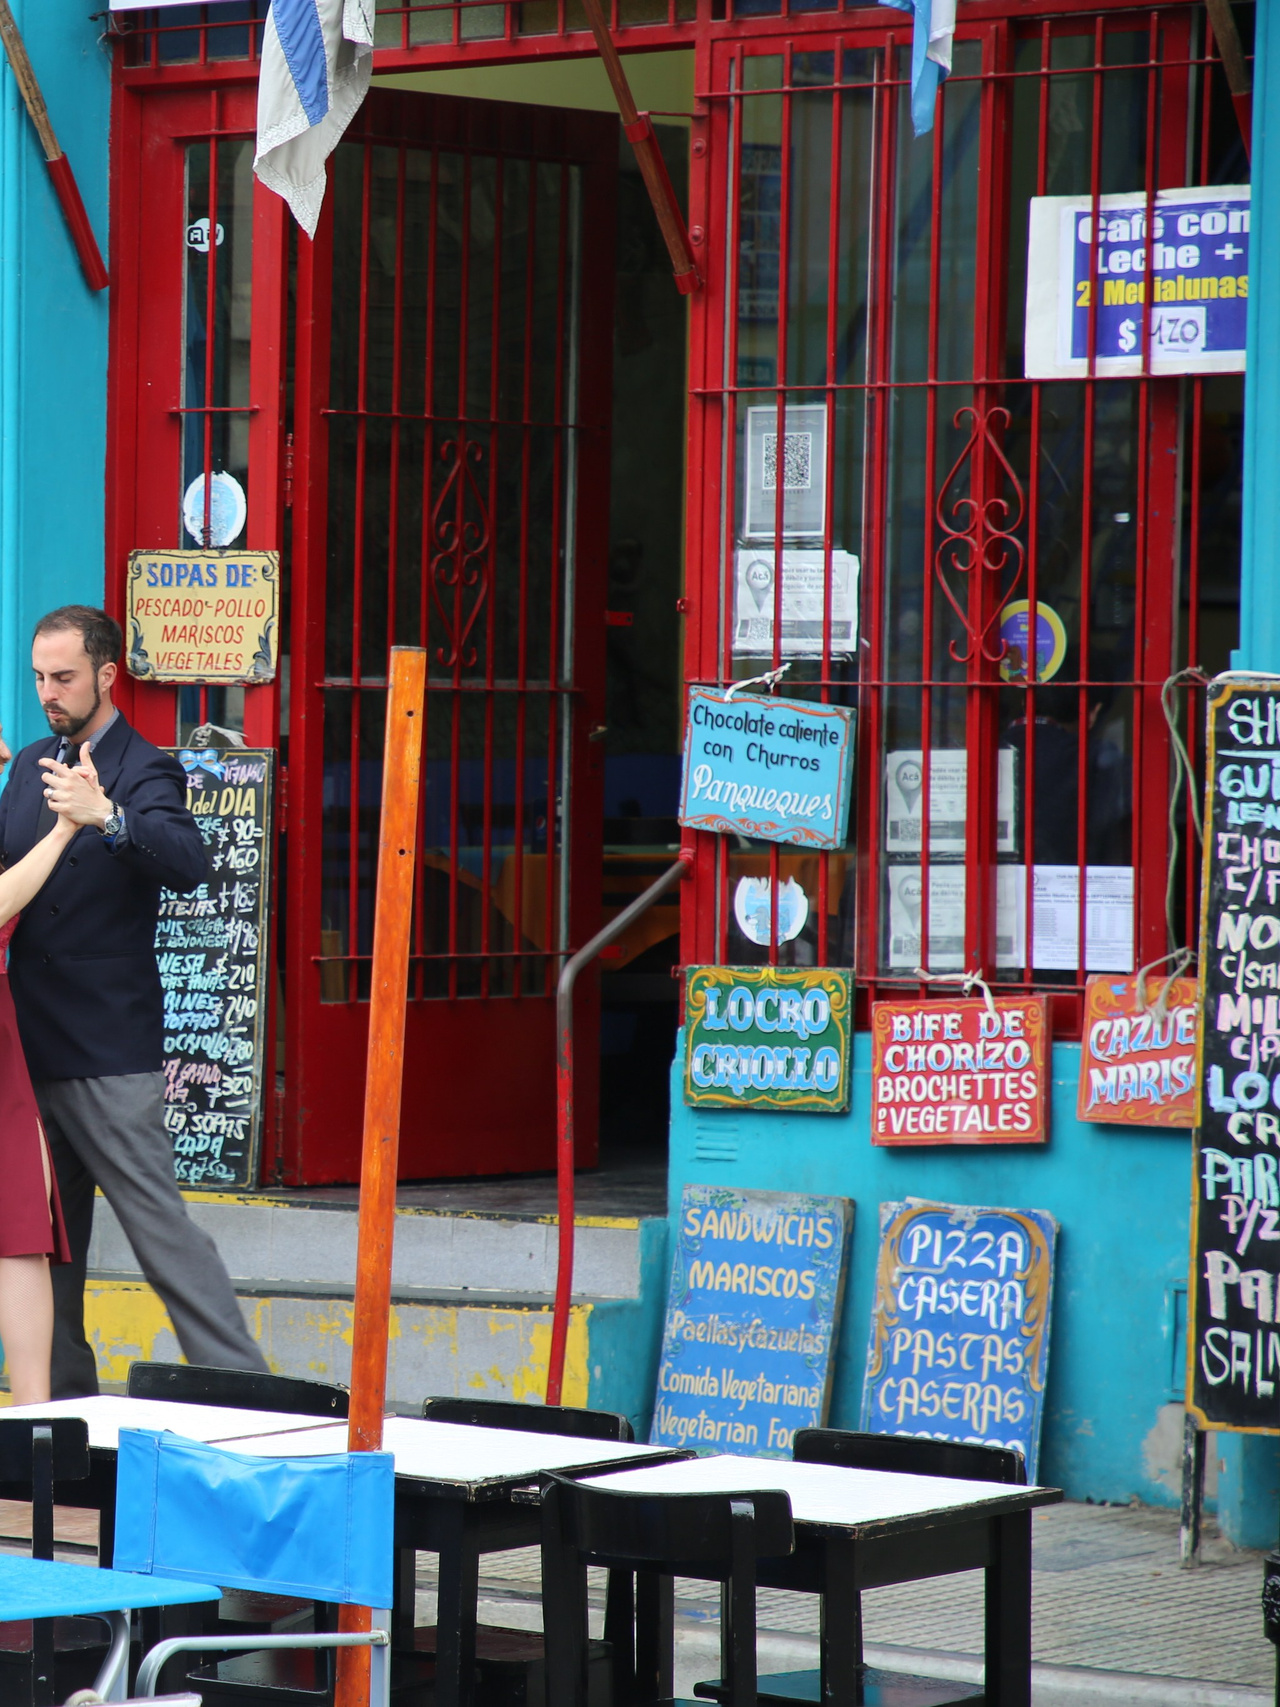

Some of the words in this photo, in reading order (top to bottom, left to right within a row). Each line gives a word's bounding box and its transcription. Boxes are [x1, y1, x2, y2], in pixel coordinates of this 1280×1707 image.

[1177, 210, 1251, 238] con
[1076, 280, 1091, 308] 2
[146, 563, 218, 588] SOPAS
[161, 625, 244, 647] MARISCOS
[156, 651, 243, 671] VEGETALES
[694, 704, 774, 738] Chocolate
[779, 719, 839, 749] caliente
[704, 740, 732, 764] con
[747, 742, 820, 771] Churros
[192, 790, 218, 815] del
[1220, 950, 1280, 994] C/SA
[702, 986, 832, 1040] LOCRO
[892, 1011, 963, 1042] BIFE
[979, 1010, 1025, 1039] DE
[691, 1043, 841, 1096] CRIOLLO
[884, 1038, 1032, 1073] CHORIZO
[878, 1071, 1038, 1103] BROCHETTES
[1086, 1055, 1196, 1113] MARIS
[1208, 1064, 1280, 1114] LO
[890, 1102, 1033, 1134] VEGETALES
[684, 1208, 834, 1249] SANDWICHS
[907, 1224, 1026, 1277] PIZZA
[689, 1260, 816, 1300] MARISCOS
[1204, 1251, 1280, 1323] PA
[898, 1276, 1024, 1331] CASERA
[891, 1327, 1025, 1382] PASTAS
[660, 1362, 719, 1397] Comida
[721, 1368, 821, 1411] Vegetariana
[879, 1376, 1026, 1435] CASERAS
